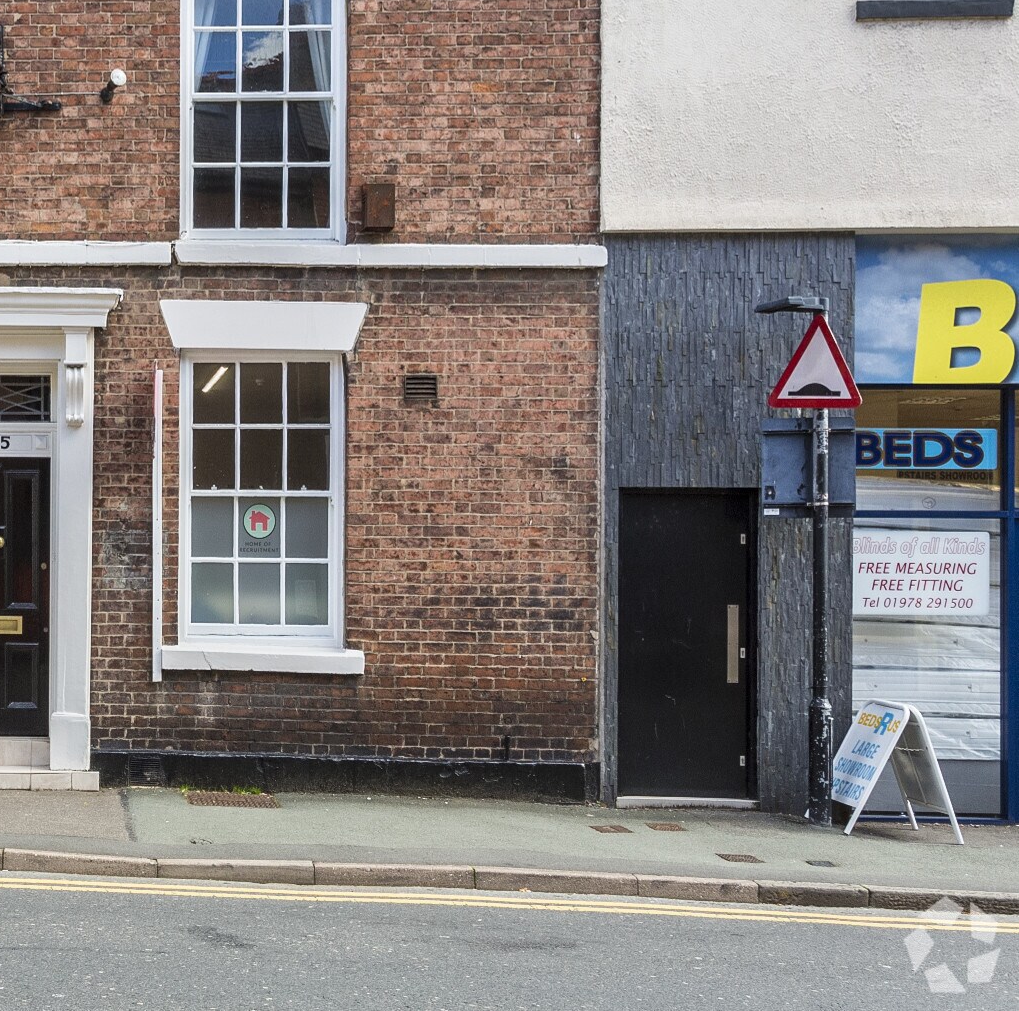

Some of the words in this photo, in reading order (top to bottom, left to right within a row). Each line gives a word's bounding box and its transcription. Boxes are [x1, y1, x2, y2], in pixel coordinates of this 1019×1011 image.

[855, 429, 985, 468] BEDS
[853, 537, 897, 555] Blinds
[900, 537, 918, 558] of
[920, 537, 940, 555] all
[943, 537, 985, 556] Kinds
[858, 562, 891, 575] FREE
[895, 562, 977, 575] MEASURING
[871, 579, 904, 591] FREE
[908, 579, 964, 592] FITTING
[862, 597, 879, 608] Tel
[883, 597, 922, 608] 01978
[926, 597, 974, 609] 291500
[851, 739, 880, 760] LARGE
[834, 756, 877, 782] SHOWROOM
[832, 776, 865, 801] PSTAIRS
